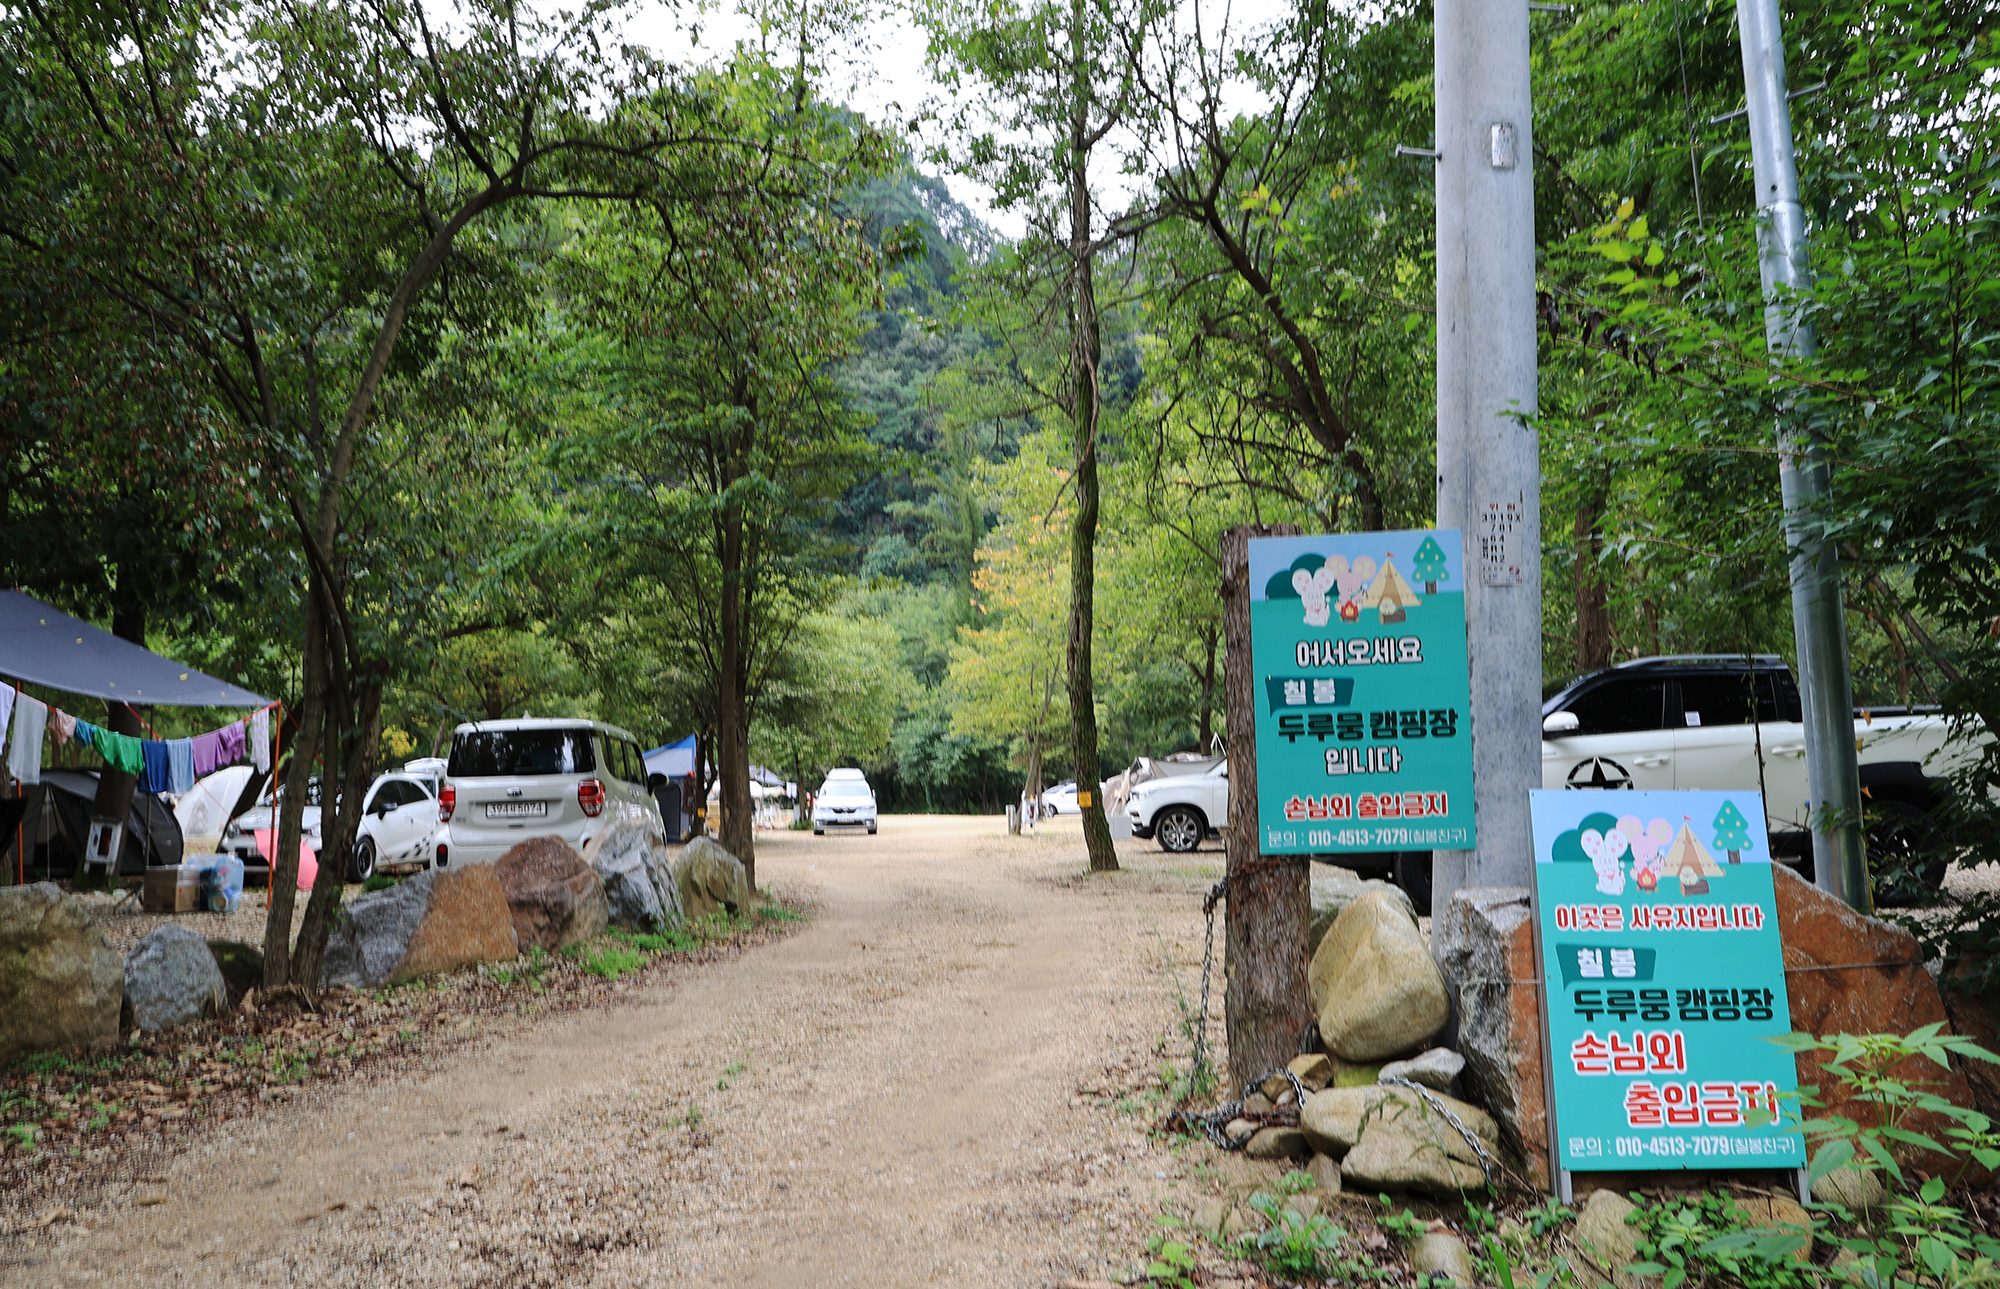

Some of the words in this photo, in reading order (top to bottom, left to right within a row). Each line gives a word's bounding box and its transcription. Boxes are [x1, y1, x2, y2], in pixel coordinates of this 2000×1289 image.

[1295, 636, 1423, 667] 어서오세요
[1278, 711, 1364, 743] 두루뭉
[1370, 708, 1459, 740] 캠핑장
[1324, 746, 1403, 776] 입니다
[1284, 794, 1352, 822] 손님외
[1357, 790, 1448, 819] 출입금지
[1555, 904, 1625, 931] 이곳은
[1631, 903, 1766, 931] 사유지입니다
[1574, 988, 1670, 1022] 두루뭉
[1675, 987, 1775, 1021] 캠핑장
[1571, 1029, 1687, 1076] 손님외
[1623, 1080, 1780, 1128] 출입금지
[1569, 1136, 1602, 1157] 문의
